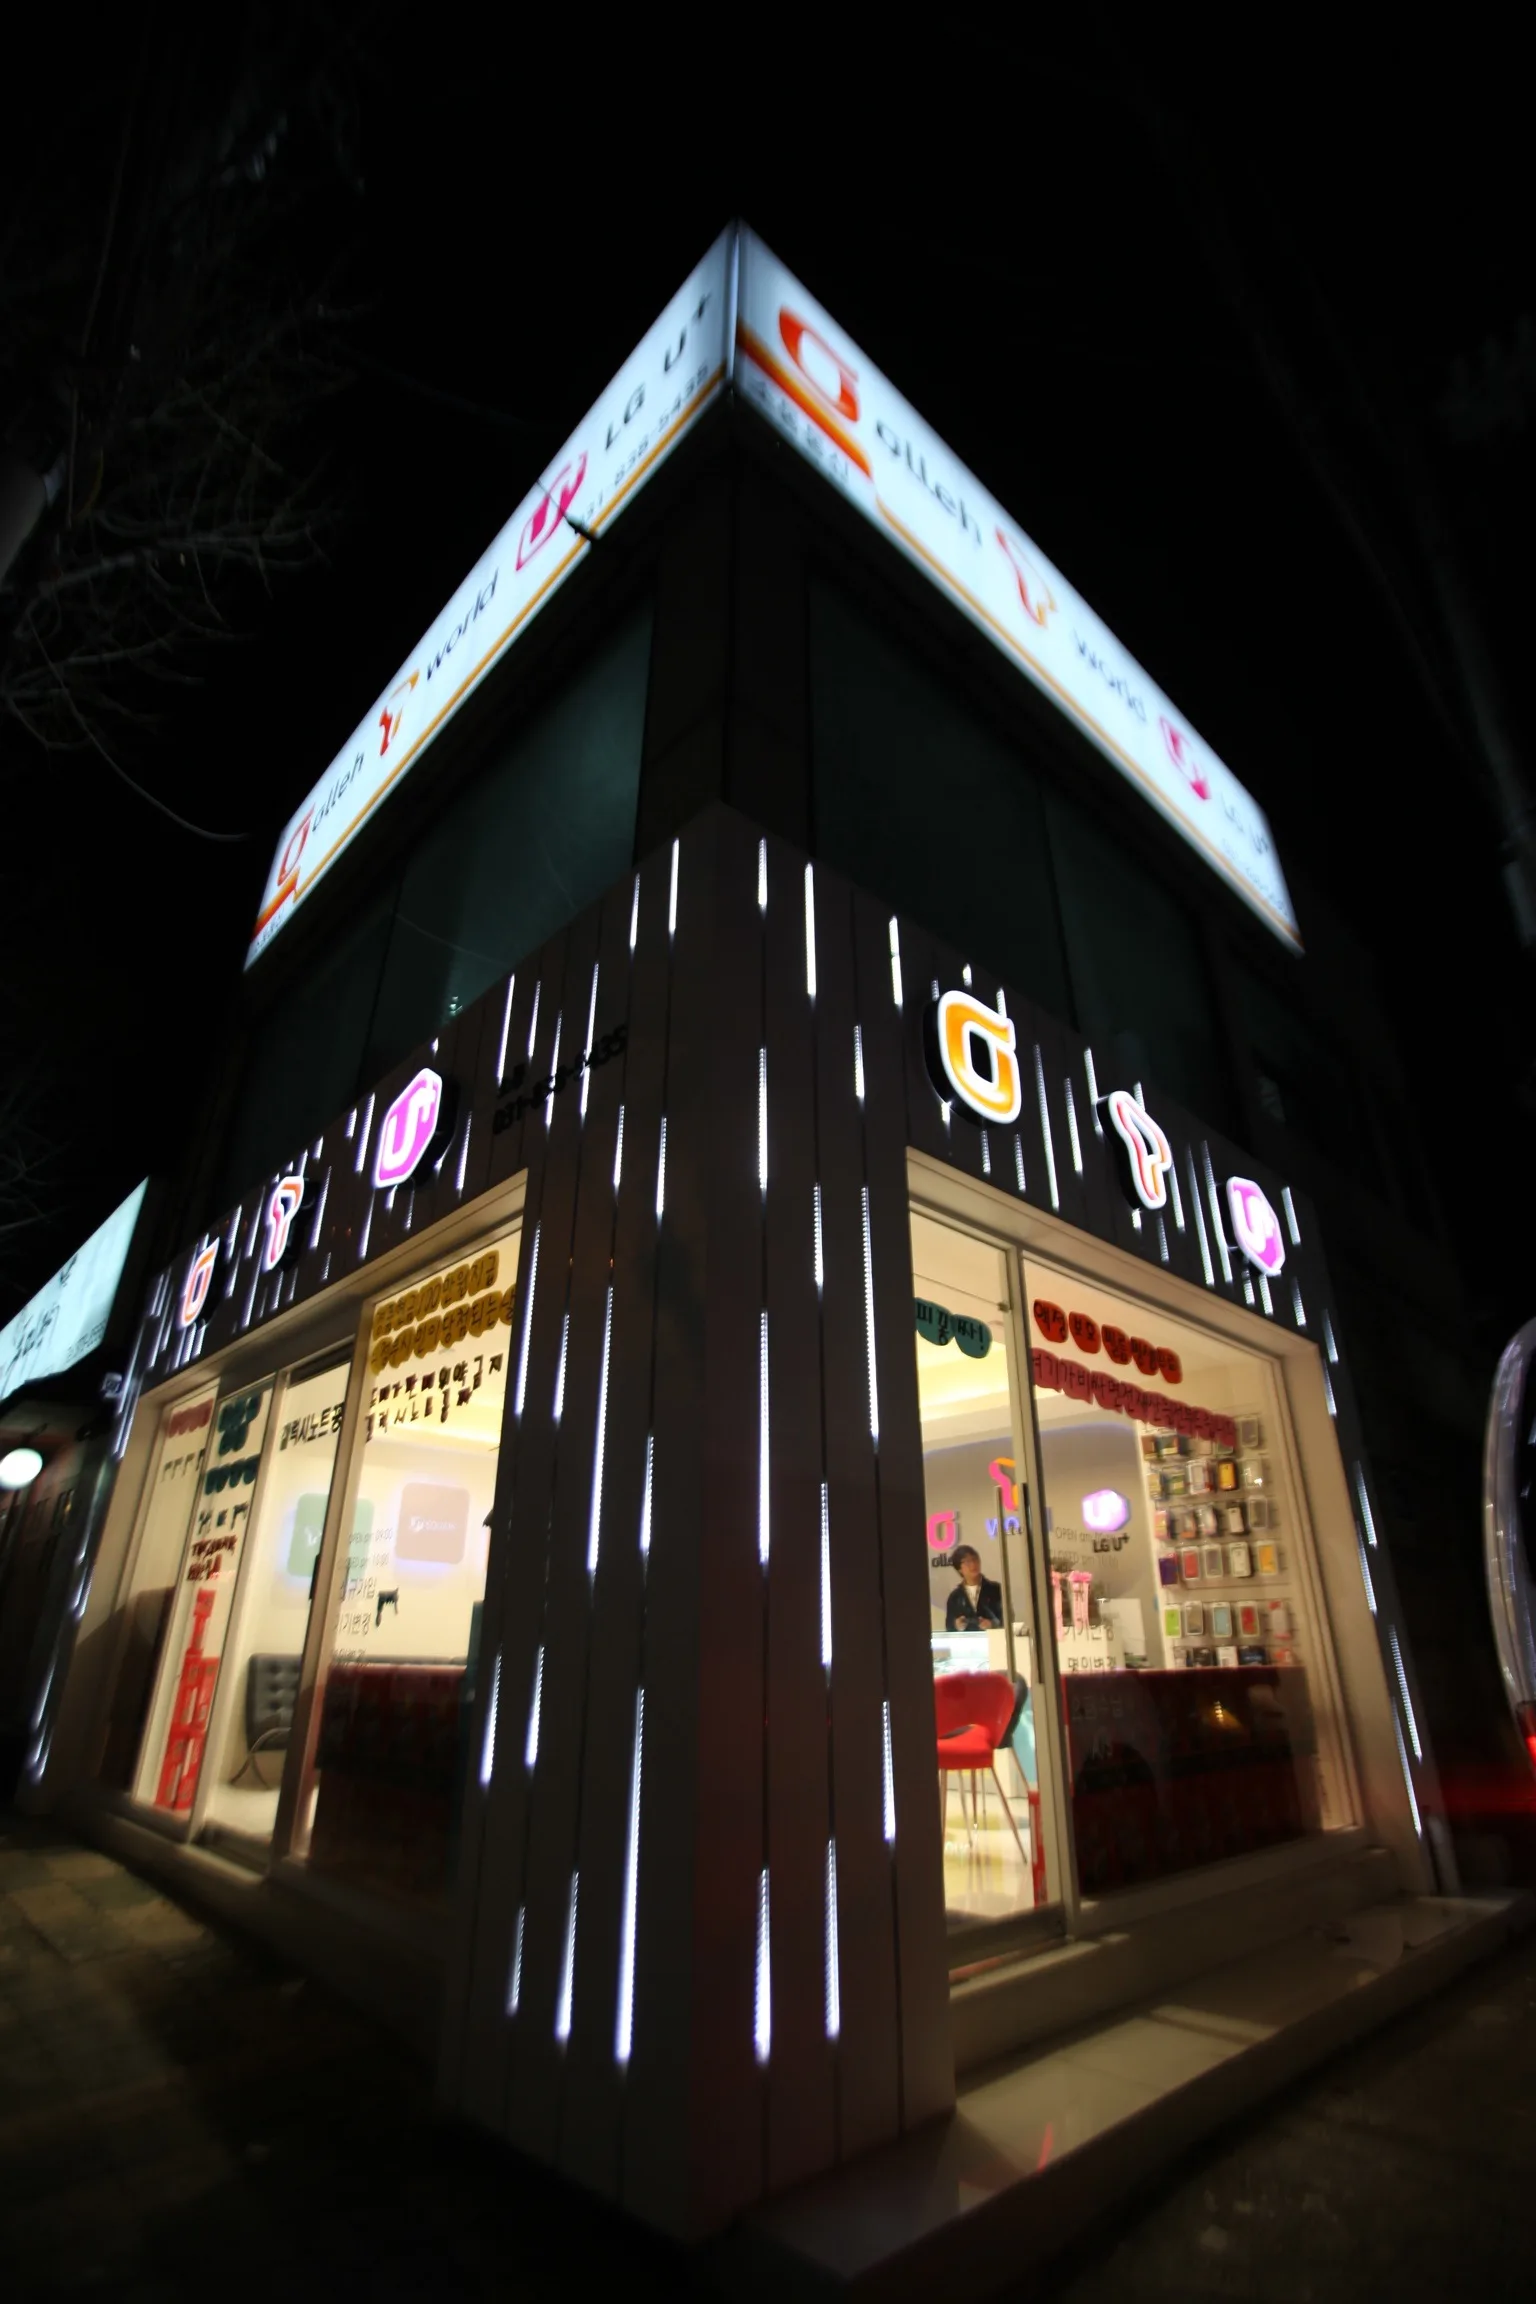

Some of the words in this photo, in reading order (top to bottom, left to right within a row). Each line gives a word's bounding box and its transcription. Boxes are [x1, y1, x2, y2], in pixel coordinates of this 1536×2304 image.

[312, 752, 364, 832] olleh
[427, 567, 499, 681] world
[604, 382, 646, 452] LG
[1093, 1539, 1110, 1553] LG
[1112, 1532, 1130, 1551] U+
